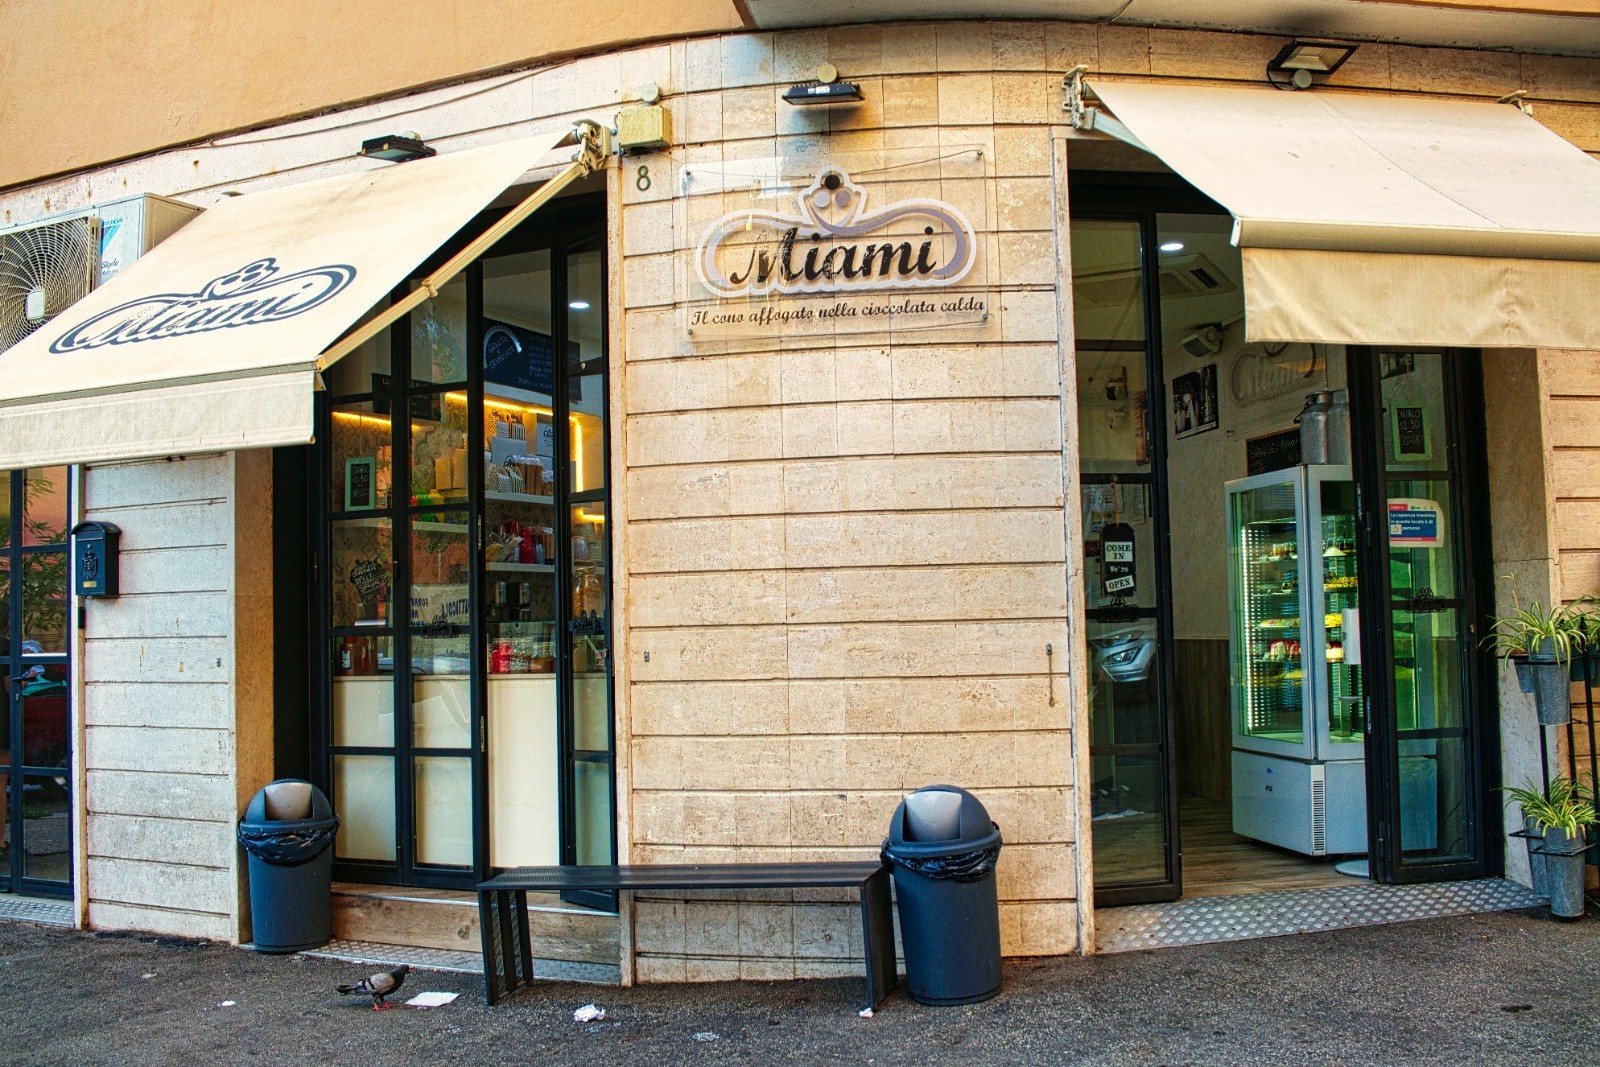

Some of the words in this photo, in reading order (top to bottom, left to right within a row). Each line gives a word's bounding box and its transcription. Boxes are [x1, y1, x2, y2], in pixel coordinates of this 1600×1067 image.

[636, 165, 651, 192] 8
[729, 226, 938, 285] Miami
[74, 282, 314, 345] Miami
[690, 310, 709, 326] Il
[712, 313, 745, 325] cono
[749, 306, 814, 327] affogato
[818, 302, 858, 318] nella
[861, 299, 937, 317] cioccolata
[940, 296, 985, 313] calda
[1106, 544, 1132, 552] COME
[1109, 565, 1129, 573] We're
[1108, 578, 1131, 590] OPEN
